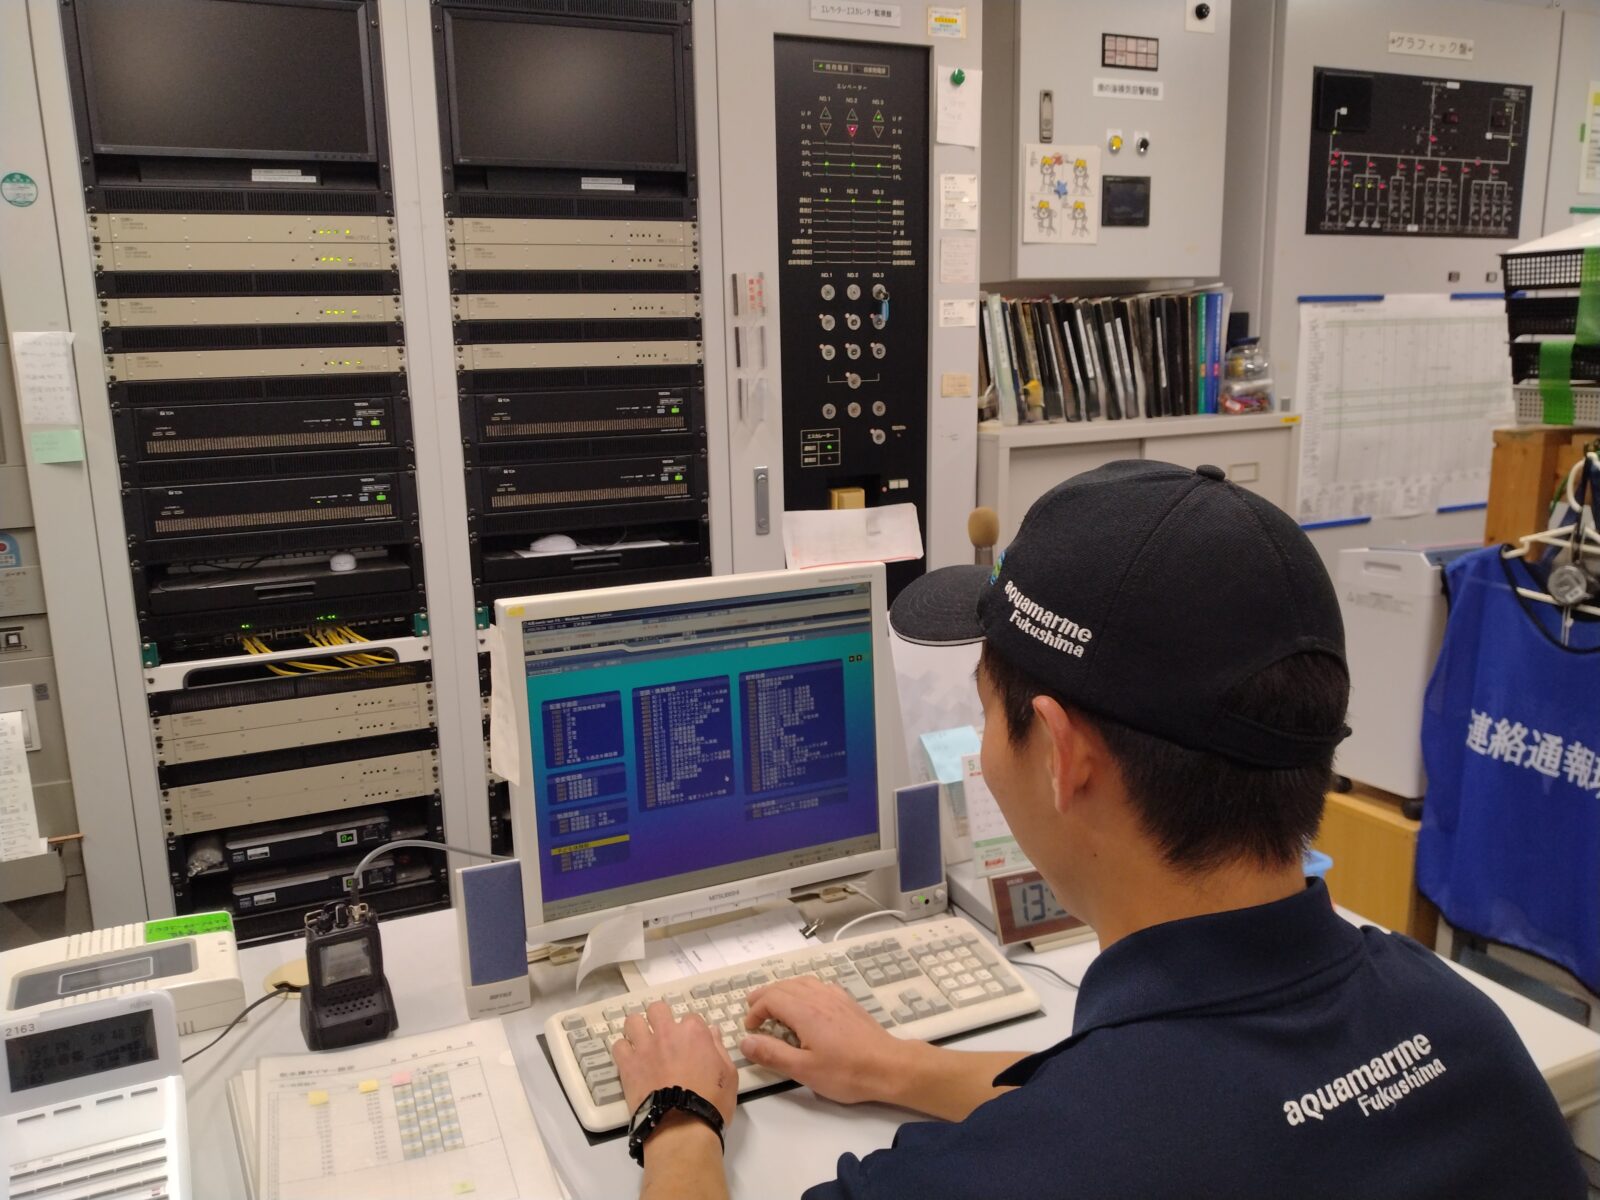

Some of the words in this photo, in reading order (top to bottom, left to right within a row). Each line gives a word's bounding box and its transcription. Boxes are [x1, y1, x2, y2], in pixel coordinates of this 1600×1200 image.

[1004, 580, 1093, 643] aquamarine
[1009, 609, 1085, 658] Fukushima
[1466, 708, 1600, 799] 連絡通報
[5, 1023, 36, 1037] 2163
[1283, 1034, 1432, 1126] aquamarine
[1357, 1058, 1447, 1117] Fukushima
